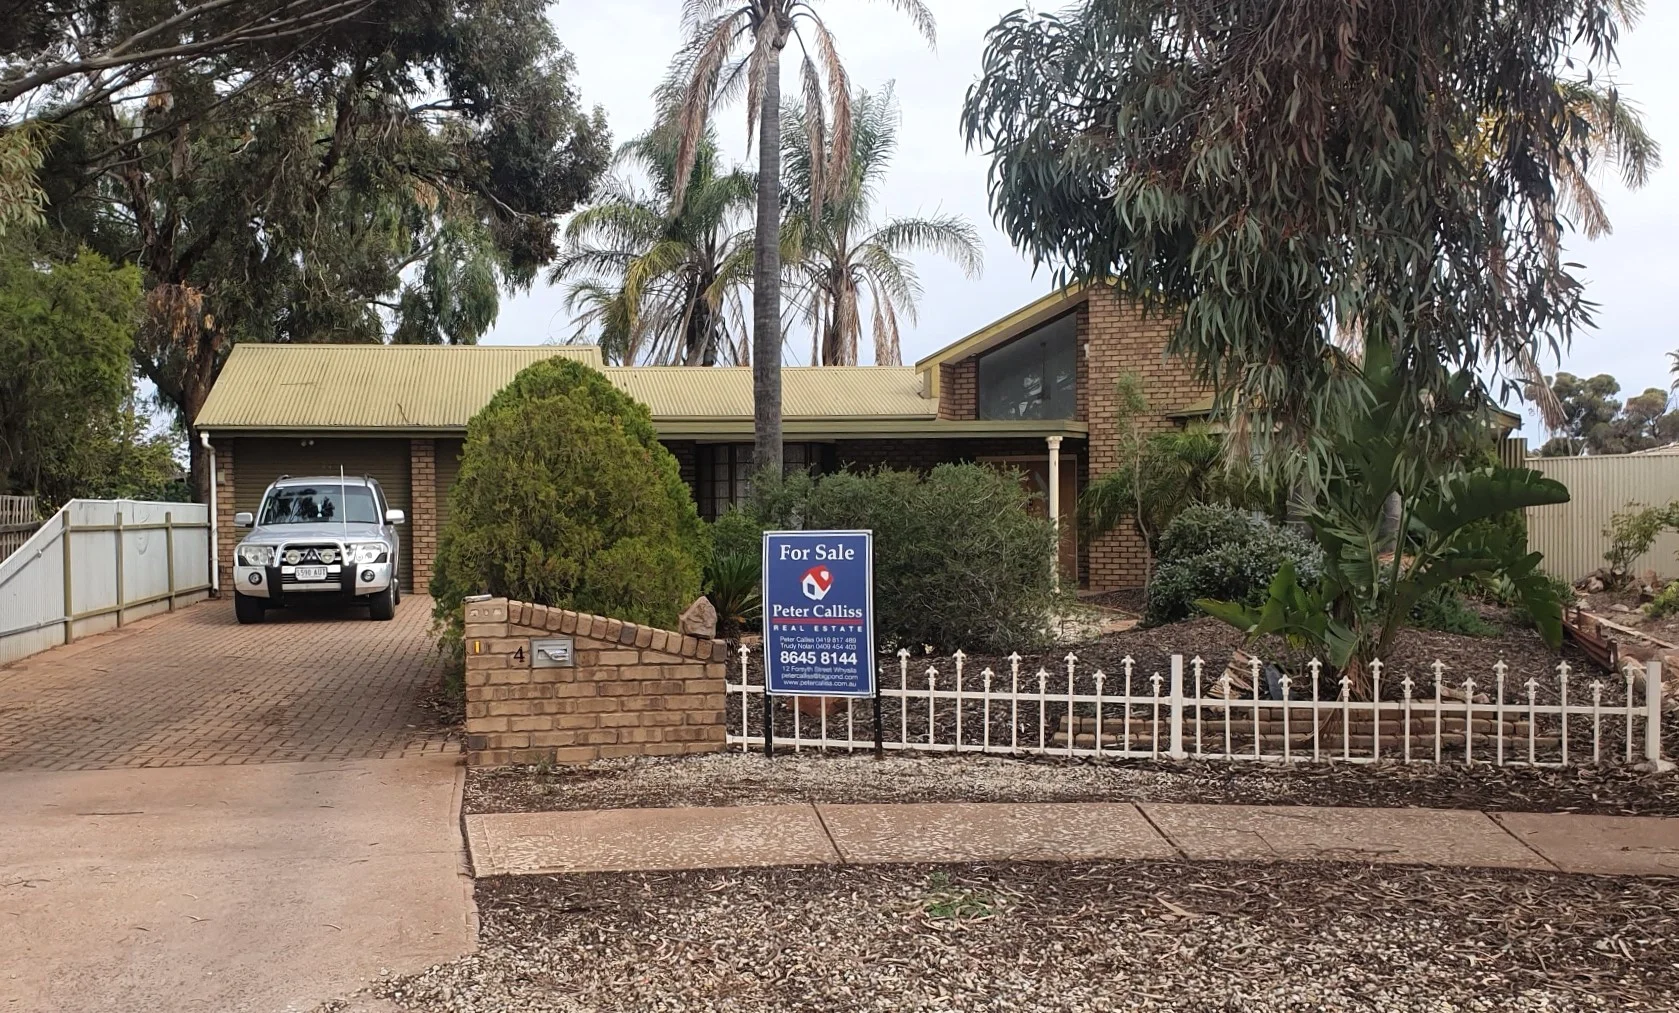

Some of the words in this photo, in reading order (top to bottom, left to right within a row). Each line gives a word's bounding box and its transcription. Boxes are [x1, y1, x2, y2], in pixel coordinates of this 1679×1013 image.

[780, 544, 810, 560] For
[815, 544, 855, 561] Sale
[773, 604, 809, 617] Peter
[813, 604, 863, 618] Calliss
[773, 624, 805, 632] REAL
[813, 625, 863, 633] ESTATE
[779, 635, 795, 643] Peter
[513, 646, 525, 663] 4
[780, 651, 816, 664] 8645
[820, 652, 858, 665] 8144
